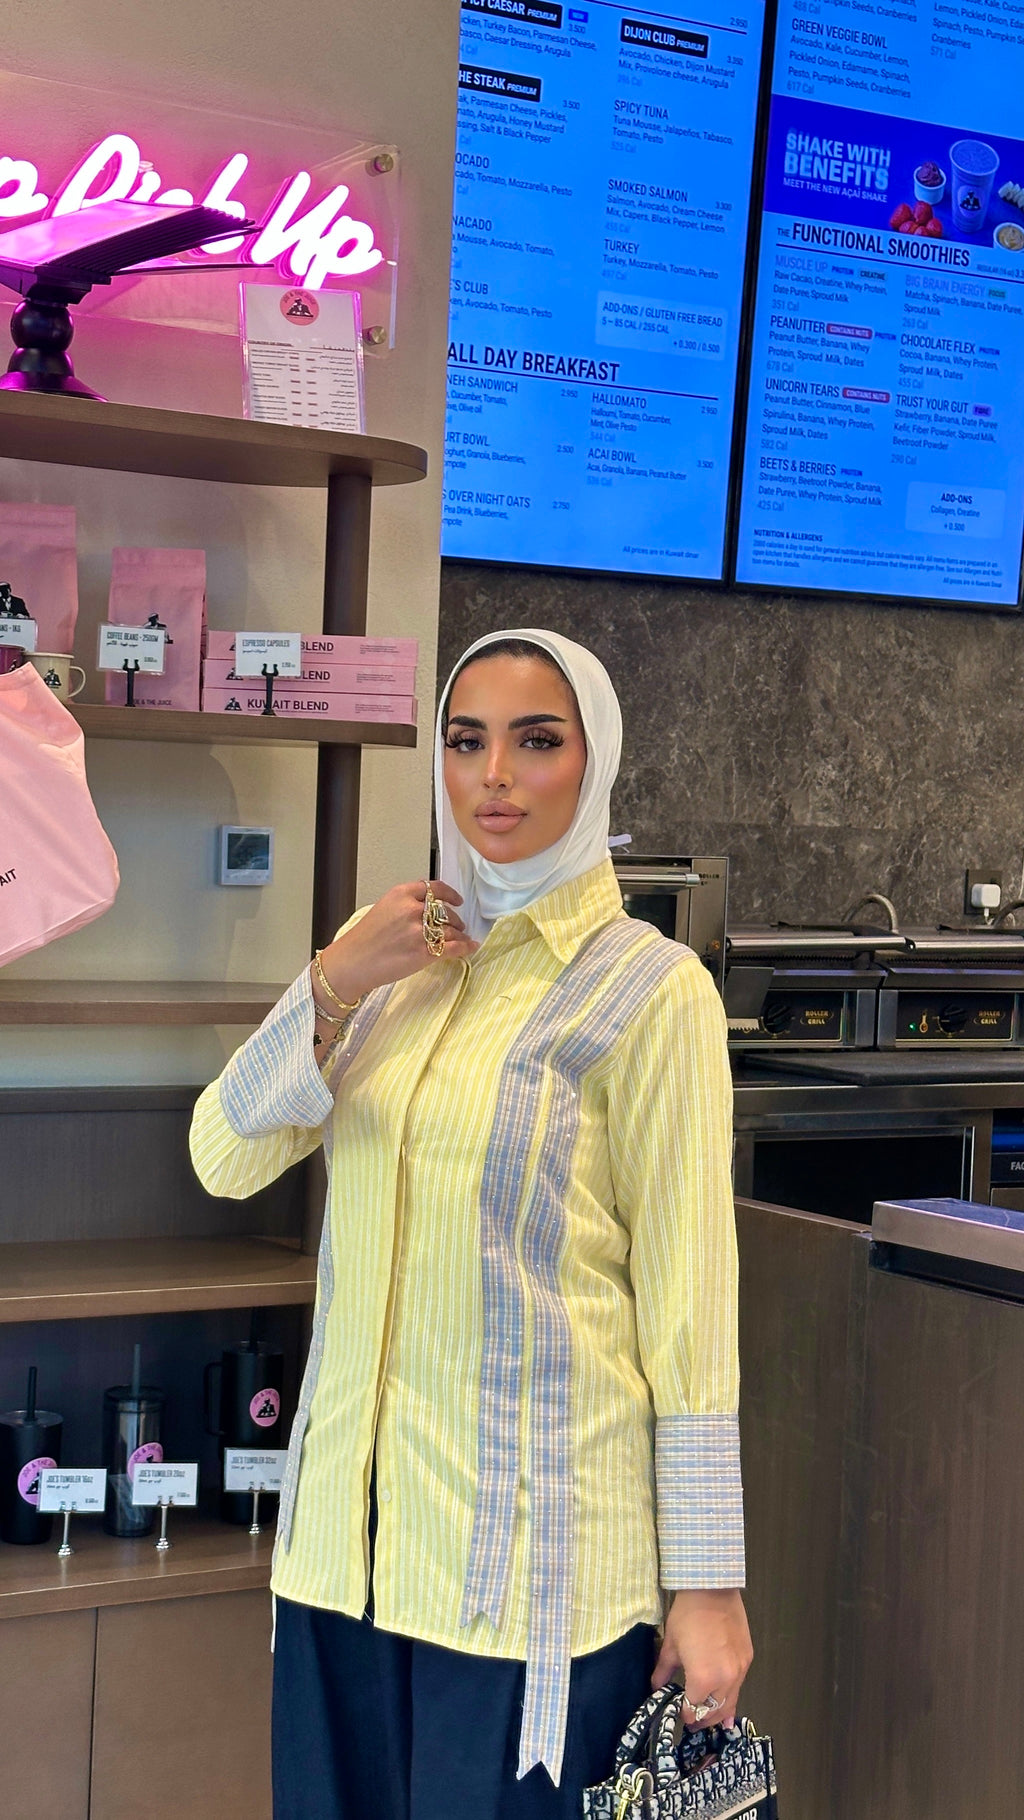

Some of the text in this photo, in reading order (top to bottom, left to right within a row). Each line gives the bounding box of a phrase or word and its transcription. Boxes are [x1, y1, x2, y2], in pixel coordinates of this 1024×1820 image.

[487, 0, 525, 15] CAESAR
[527, 8, 558, 21] PREMIUM
[484, 19, 597, 51] Turkey Bacon, Parmesan Cheese,
[568, 23, 586, 34] 3.500
[624, 25, 705, 52] DIJON CLUB PREMIUM
[791, 17, 888, 50] GREEN VEGGIE BOWL
[790, 34, 910, 68] Avocado, Kale, Cucumber, Lemon,
[619, 48, 736, 78] Avocado, Chicken, Dijon Mustard
[473, 73, 506, 91] STEAK
[507, 82, 538, 96] PREMIUM
[470, 95, 568, 123] Parmesan Cheese, Pickles,
[562, 99, 580, 110] 3.500
[614, 99, 669, 120] SPICY TUNA
[613, 115, 631, 126] Tuna
[633, 118, 662, 133] Mousse,
[703, 131, 734, 146] Tabasco,
[613, 126, 664, 145] Tomato, Pesto
[786, 131, 892, 168] SHAKE WITH
[455, 152, 490, 169] OCADO
[783, 151, 890, 191] BENEFITS
[477, 172, 573, 197] Tomato, Mozzarella, Pesto
[608, 178, 688, 203] SMOKED SALMON
[783, 177, 805, 189] MEET
[806, 181, 822, 192] THE
[822, 184, 841, 196] NEW
[861, 192, 888, 204] SHAKE
[606, 194, 724, 222] Salmon, Avocado, Cream Cheese
[249, 170, 384, 290] Up
[604, 238, 640, 255] TURKEY
[776, 221, 970, 268] THE FUNCTIONAL SMOOTHIES
[603, 254, 719, 280] Turkey, Mozzarella, Tomato, Pesto
[775, 254, 829, 273] MUSCLE UP
[463, 280, 489, 295] CLUB
[904, 274, 986, 297] BIG BRAIN ENERGY
[602, 301, 723, 328] ADD-ONS GLUTEN FREE BREAD
[770, 314, 826, 334] PEANUTTER
[624, 318, 670, 335] CAL 255 CAL
[701, 341, 720, 354] 0.500
[768, 330, 871, 355] Peanut Butter, Banana, Whey
[900, 332, 976, 356] CHOCOLATE FLEX
[447, 341, 620, 382] ALL DAY BREAKFAST
[467, 375, 518, 393] SANDWICH
[560, 388, 579, 399] 2.950
[764, 377, 840, 398] UNICORN TEARS
[592, 391, 647, 409] HALLOMATO
[895, 393, 969, 414] TRUST YOUR GUT
[701, 406, 718, 416] 2.950
[462, 432, 490, 447] BOWL
[556, 444, 575, 455] 2.500
[587, 447, 637, 464] ACAI BOWL
[696, 459, 714, 469] 3.500
[759, 456, 837, 476] BEETS & BERRIES
[448, 489, 531, 509] OVER NIGHT OATS
[940, 492, 973, 505] ADD-ONS
[753, 529, 786, 539] NUTRITION
[791, 532, 823, 543] ALLERGENS
[242, 639, 290, 648] ESPRESSO CAPSULES
[300, 641, 334, 652] BLEND
[295, 670, 331, 681] LEND
[293, 700, 329, 711] BLEND
